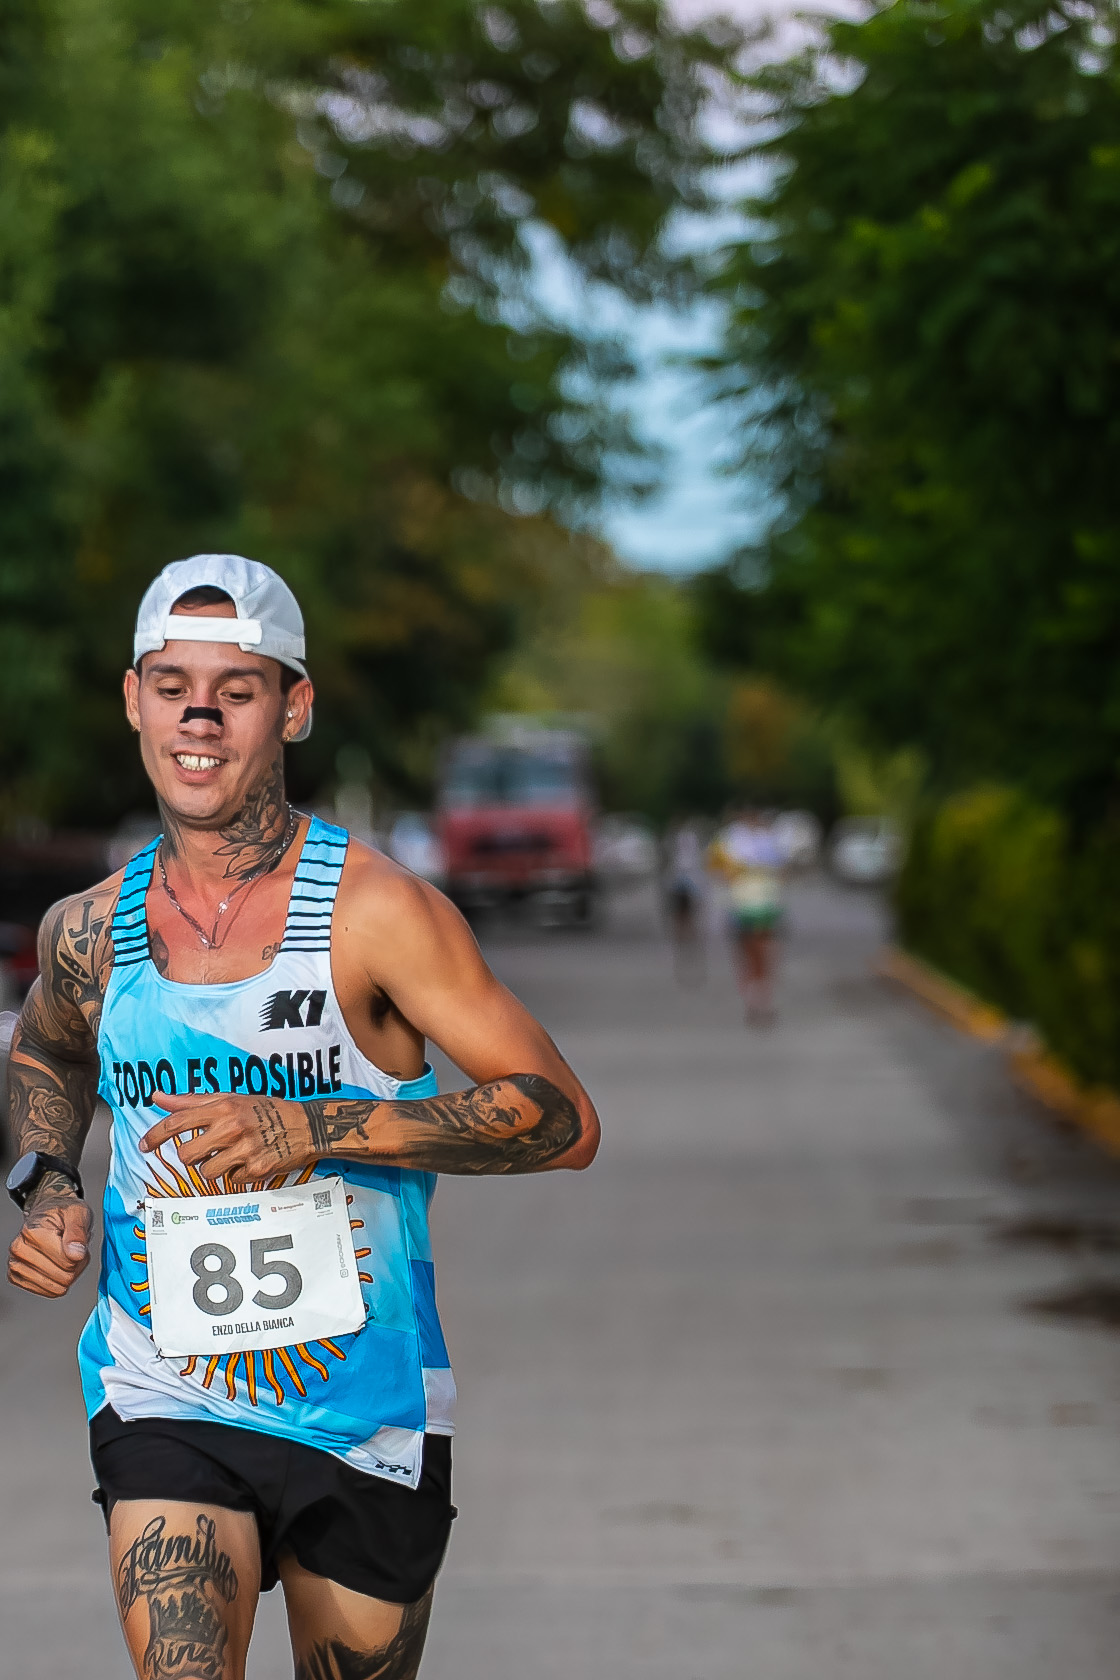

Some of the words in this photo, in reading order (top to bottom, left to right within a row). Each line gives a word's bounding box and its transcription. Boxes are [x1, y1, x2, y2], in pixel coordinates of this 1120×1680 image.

[112, 1057, 177, 1110] TODO
[186, 1056, 220, 1095] ES
[228, 1043, 343, 1100] POSIBLE
[189, 1233, 303, 1317] 85
[211, 1324, 234, 1337] ENZO
[235, 1320, 262, 1335] DELLA
[262, 1315, 295, 1331] BIANCA
